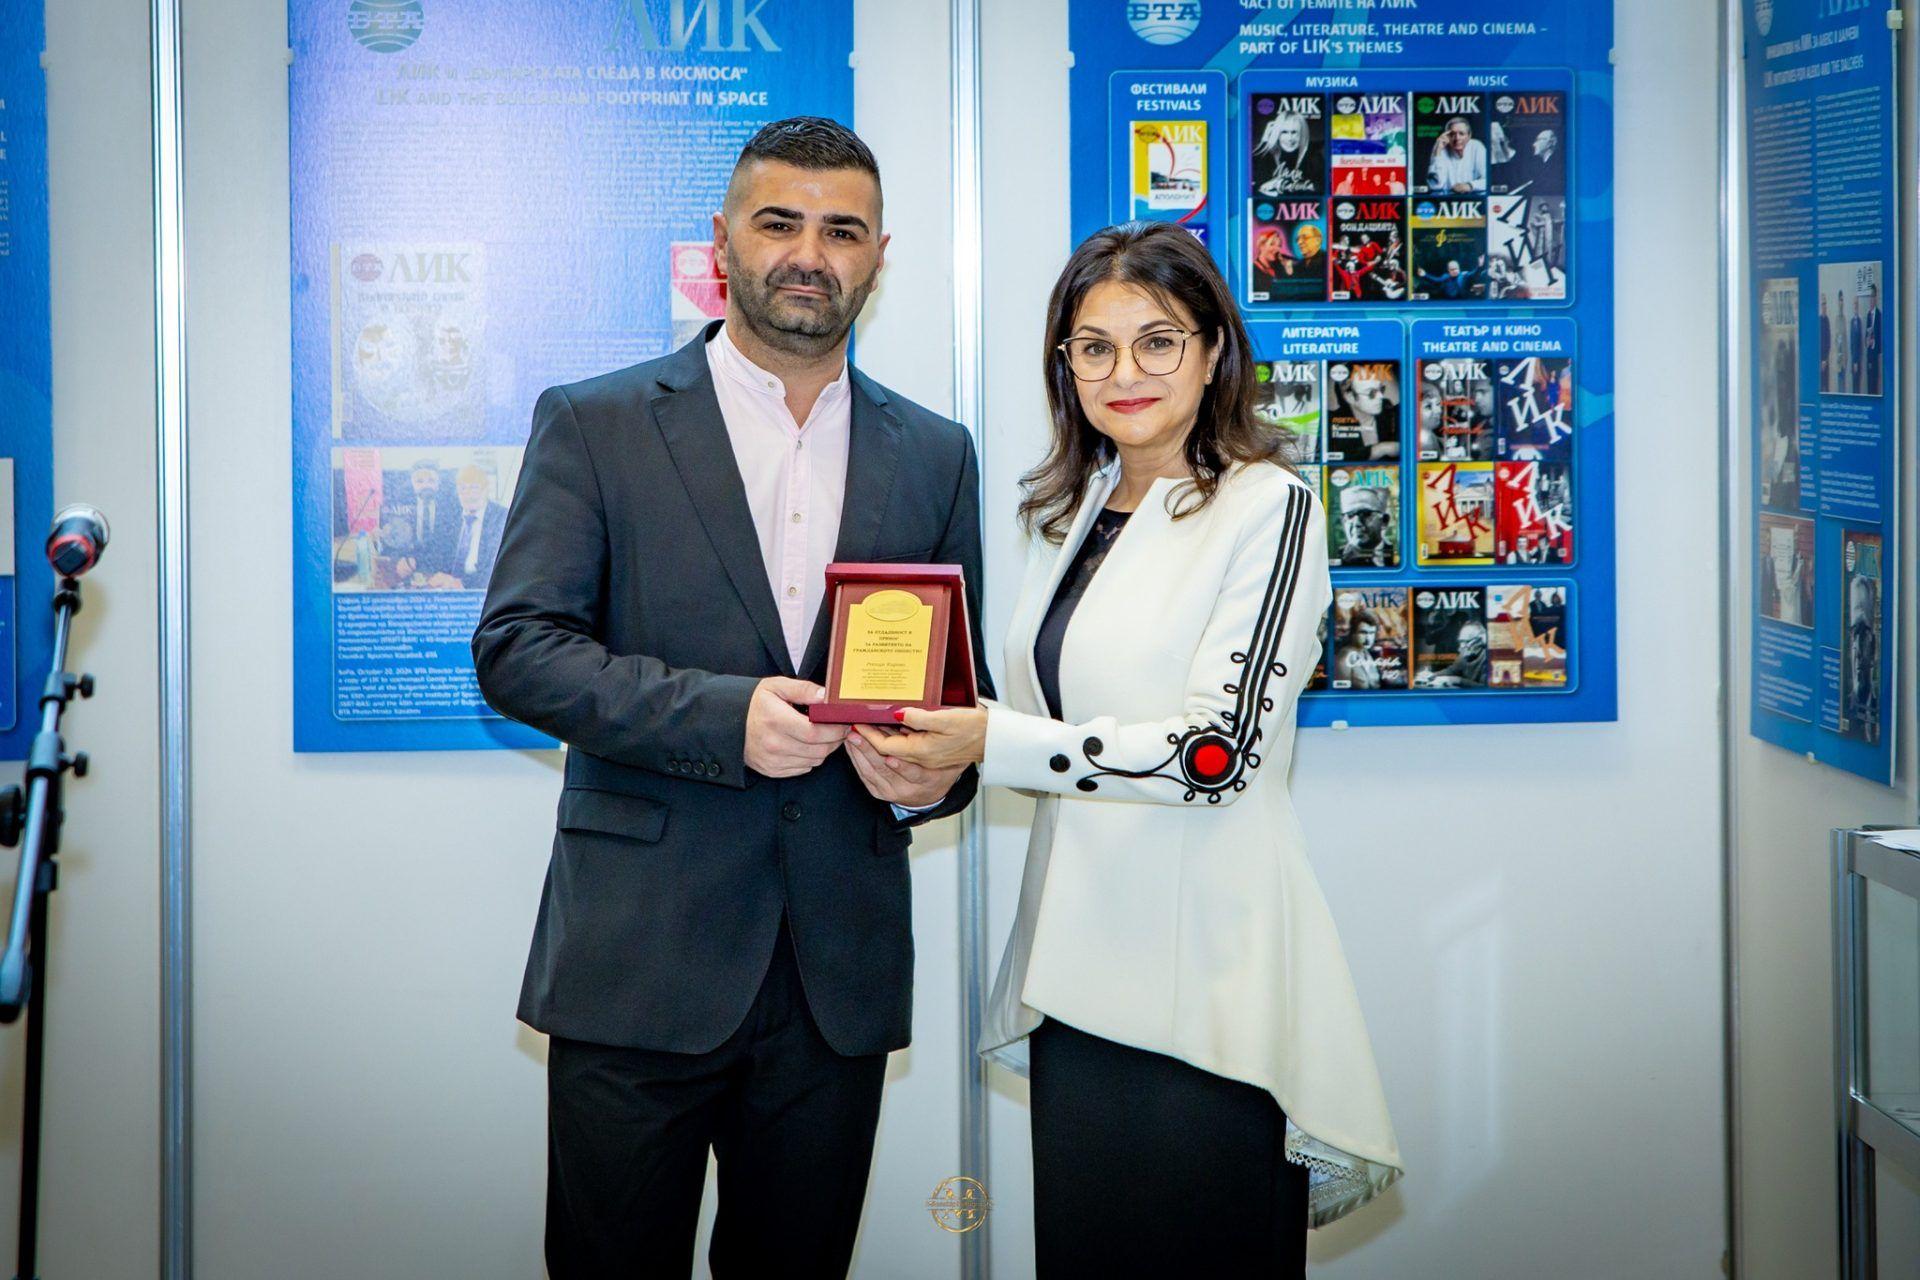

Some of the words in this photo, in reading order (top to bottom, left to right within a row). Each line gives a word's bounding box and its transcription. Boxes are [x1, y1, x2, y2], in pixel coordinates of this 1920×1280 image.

[1127, 2, 1199, 22] БТА
[1239, 24, 1288, 37] MUSIC,
[1292, 24, 1379, 37] LITERATURE,
[1384, 23, 1444, 36] THEATRE
[1448, 23, 1477, 35] AND
[1482, 22, 1536, 35] CINEMA
[1239, 42, 1275, 54] PART
[1279, 42, 1298, 54] OF
[1347, 41, 1403, 54] THEMES
[587, 66, 641, 80] СЛЕДА
[645, 66, 655, 80] В
[1305, 75, 1359, 88] МУЗИКА
[1467, 74, 1510, 87] MUSIC
[1130, 83, 1207, 96] ФЕСТИВАЛИ
[596, 91, 690, 105] FOOTPRINT
[696, 91, 714, 105] IN
[717, 91, 769, 106] SPACE
[1136, 99, 1202, 112] FESTIVALS
[1278, 97, 1322, 114] ЛИК
[1357, 96, 1404, 114] ЛИК
[1435, 96, 1481, 114] ЛИК
[1515, 96, 1559, 114] ЛИК
[1161, 125, 1203, 143] ЛИК
[1275, 202, 1320, 221] ЛИК
[1356, 202, 1401, 221] ЛИК
[1436, 201, 1483, 220] ЛИК
[390, 252, 472, 283] ЛИК
[1282, 326, 1361, 340] ЛИТЕРАТУРА
[1442, 324, 1490, 337] ТЕАТЪР
[1493, 324, 1503, 337] И
[1506, 324, 1542, 337] КИНО
[1282, 342, 1360, 355] LITERATURE
[1422, 341, 1477, 354] THEATRE
[1481, 341, 1509, 353] AND
[1511, 340, 1563, 353] CINEMA
[1270, 363, 1317, 382] ЛИК
[1350, 363, 1393, 382] ЛИК
[1441, 362, 1488, 381] ЛИК
[1435, 591, 1481, 610] ЛИК
